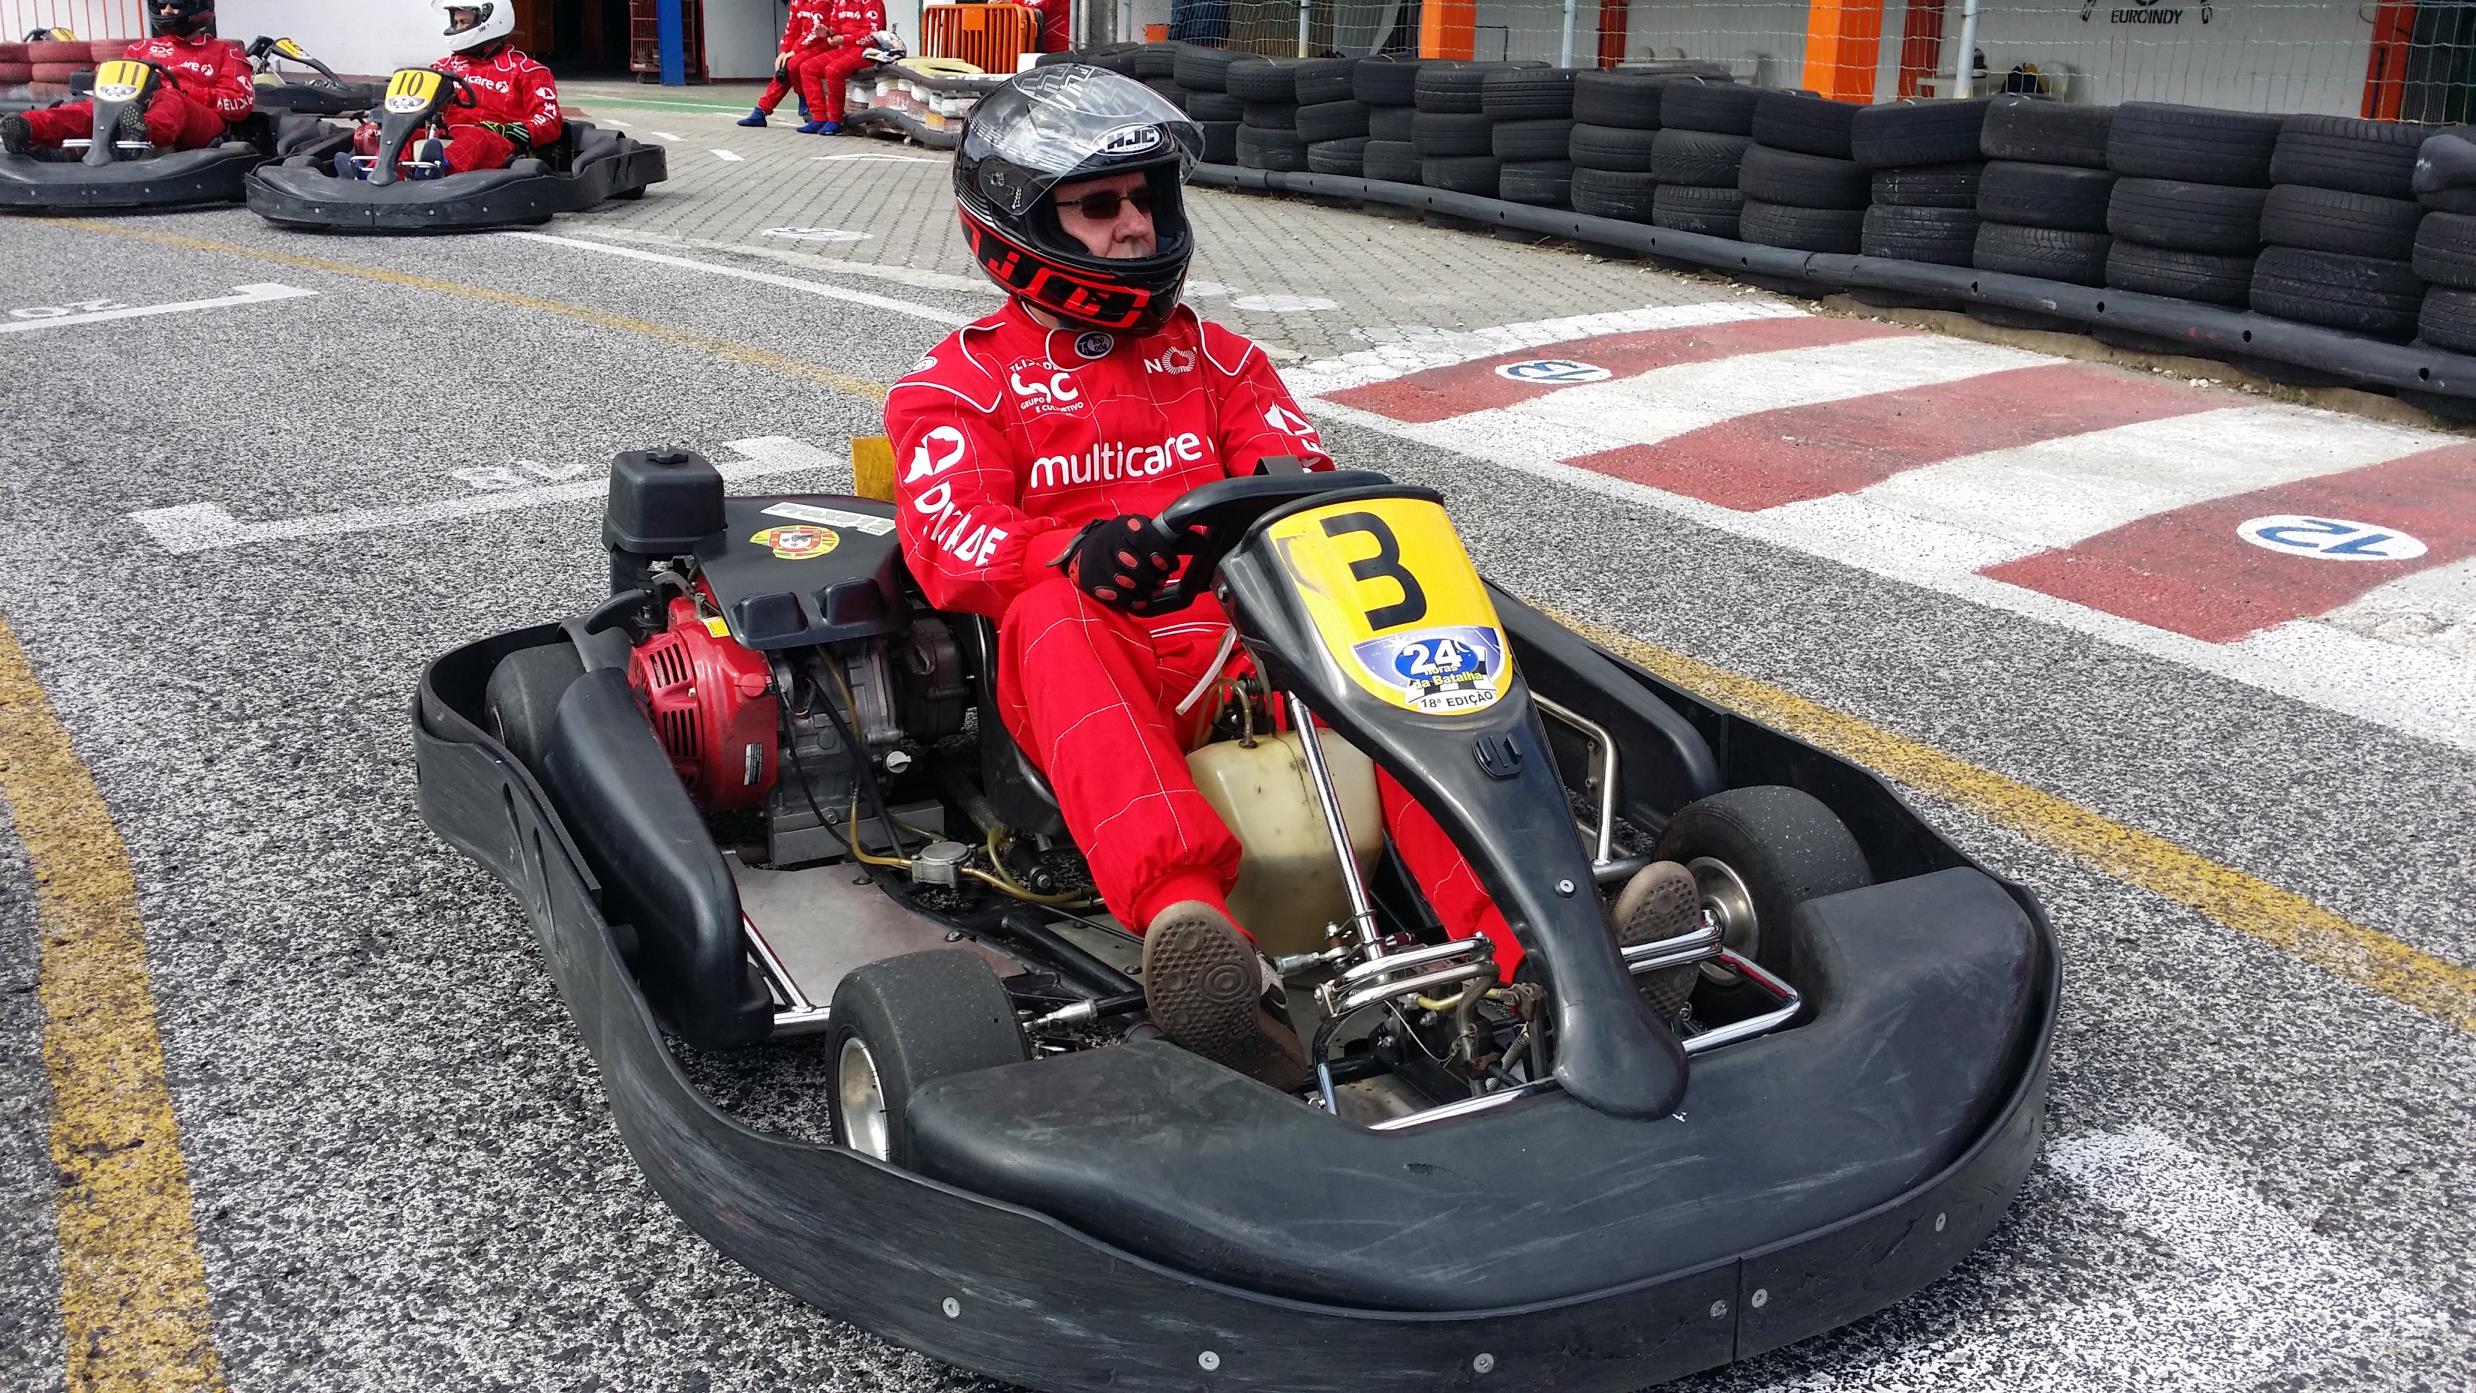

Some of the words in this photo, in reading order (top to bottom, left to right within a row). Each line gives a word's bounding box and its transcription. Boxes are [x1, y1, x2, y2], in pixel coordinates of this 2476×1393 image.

[2111, 10, 2182, 24] EUROINDY
[117, 62, 141, 86] 11
[395, 71, 424, 97] 10
[1107, 128, 1155, 150] HJC
[1020, 397, 1045, 409] GRUPO
[1031, 432, 1202, 489] multicare
[2255, 519, 2396, 557] 12
[1320, 512, 1427, 631] 3
[1404, 639, 1462, 675] 24
[1433, 672, 1482, 686] Batalha
[1447, 691, 1493, 707] EDIÇÃO
